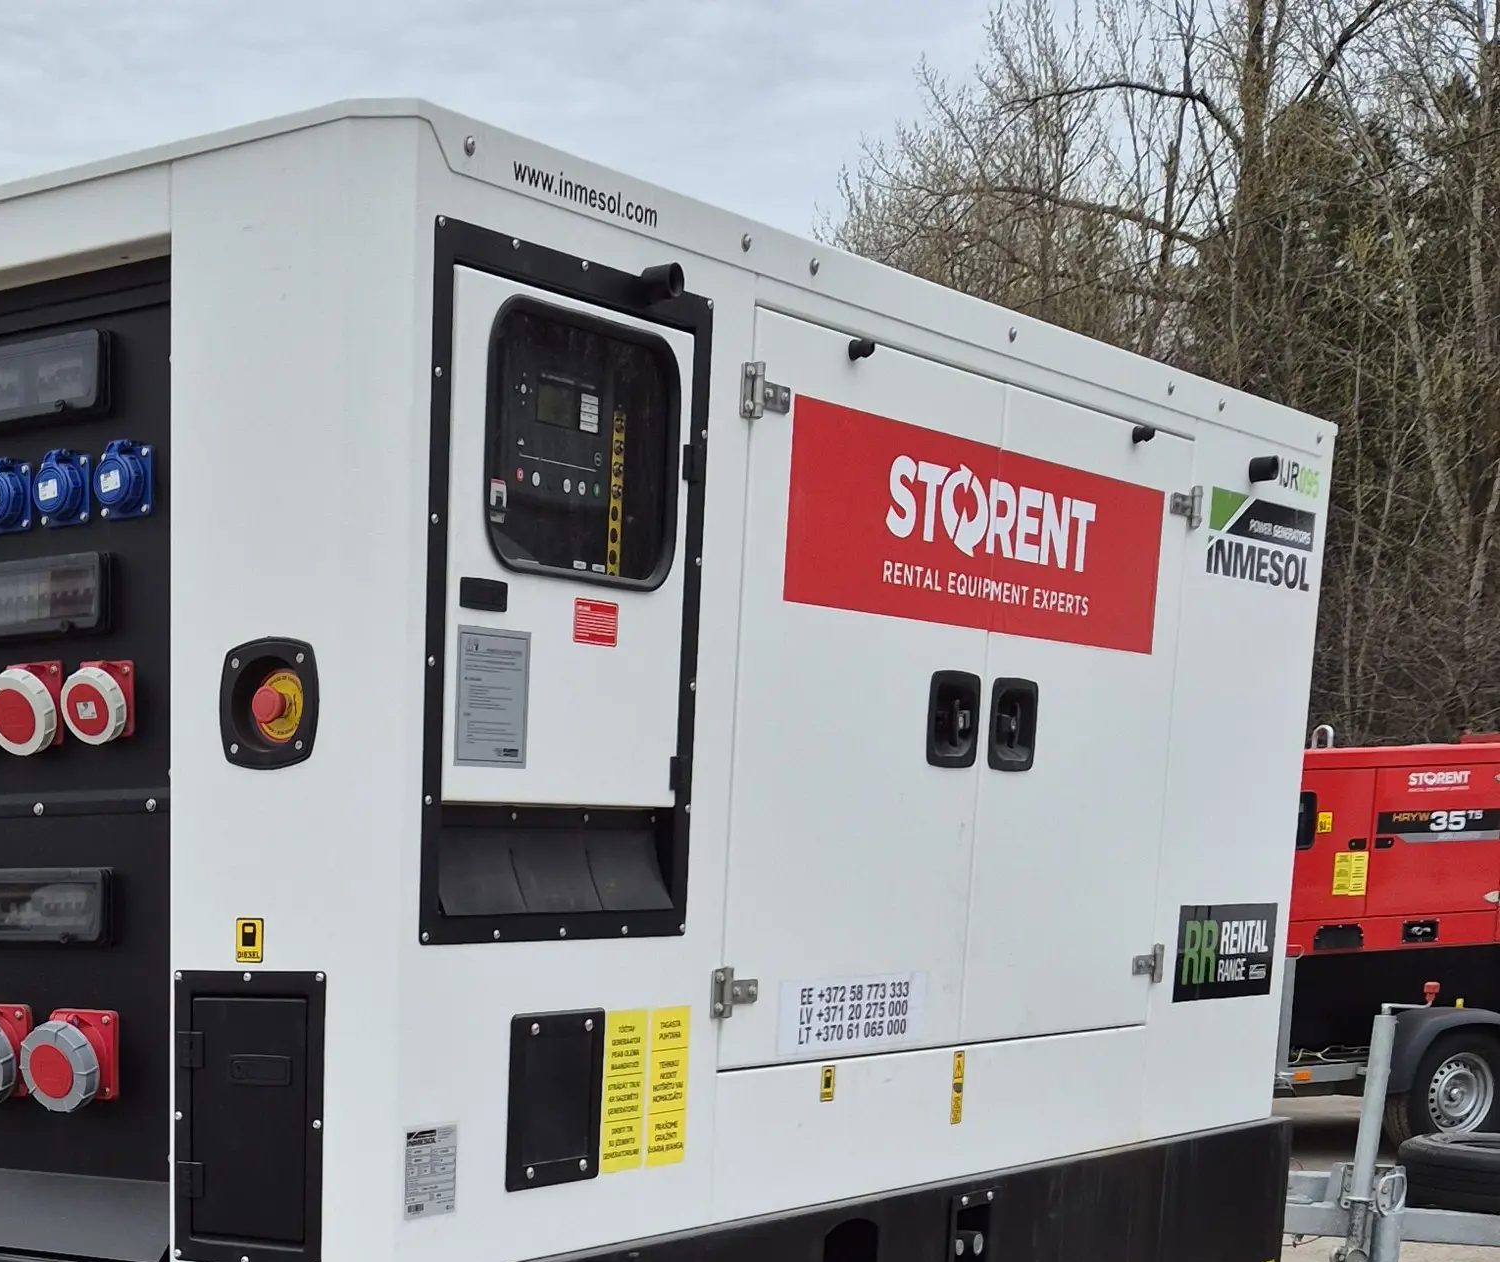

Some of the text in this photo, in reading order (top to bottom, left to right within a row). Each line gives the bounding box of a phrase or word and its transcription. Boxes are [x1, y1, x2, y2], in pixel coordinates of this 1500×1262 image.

[513, 160, 658, 228] www.inmesol.com
[885, 455, 1096, 573] STORENT
[1206, 536, 1310, 592] INMESOL
[883, 560, 1090, 616] RENTAL EQUIPMENT EXPERTS
[1408, 771, 1471, 786] STORENT
[1220, 920, 1268, 955] RENTAL
[1217, 958, 1247, 982] RANGE
[800, 981, 909, 1005] EE +372 58 773 333
[800, 999, 908, 1025] LV +371 20 275 000
[798, 1018, 906, 1045] LT +370 61 065 000
